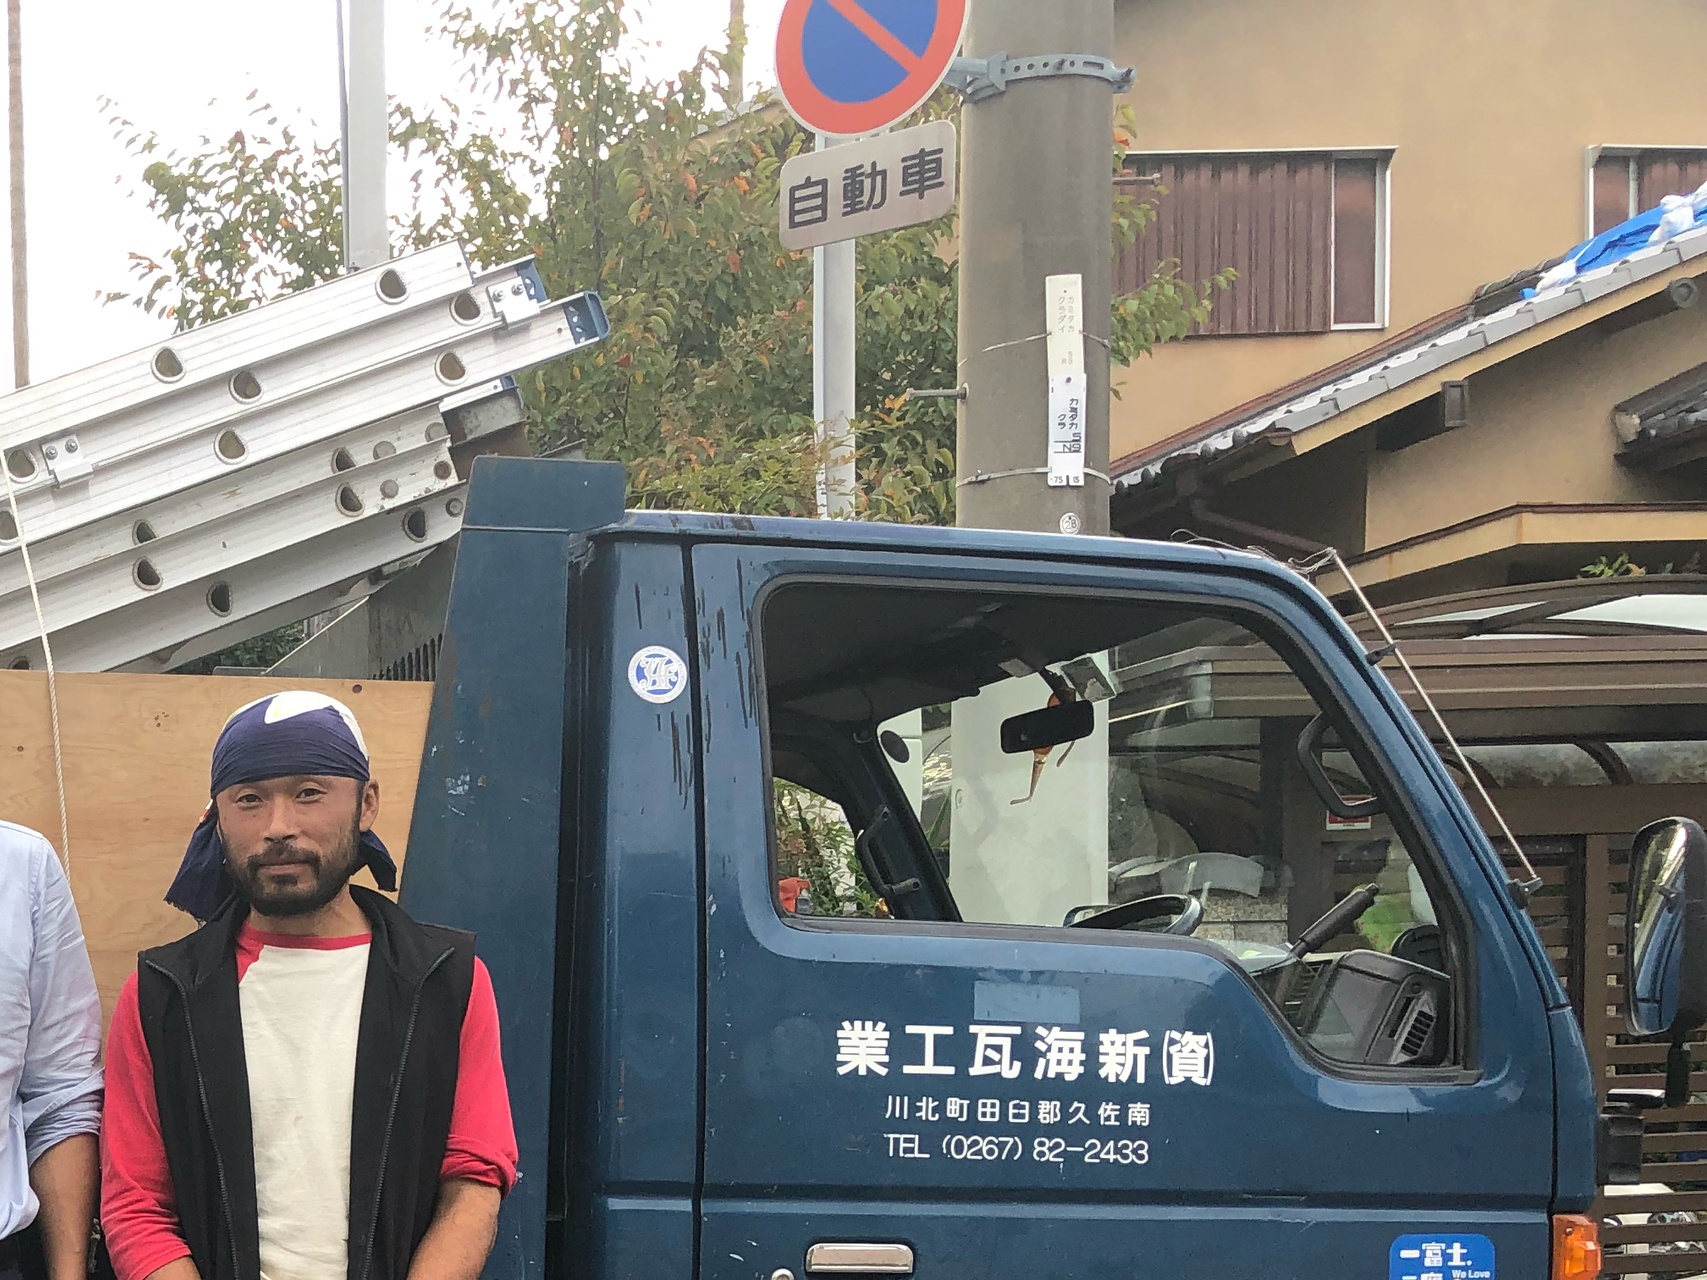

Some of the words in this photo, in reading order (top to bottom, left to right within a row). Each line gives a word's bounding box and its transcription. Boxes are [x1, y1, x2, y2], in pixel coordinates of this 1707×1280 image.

[789, 147, 945, 229] 自動車
[886, 1133, 930, 1159] TEL
[1451, 1269, 1467, 1278] We
[1468, 1269, 1491, 1278] Love
